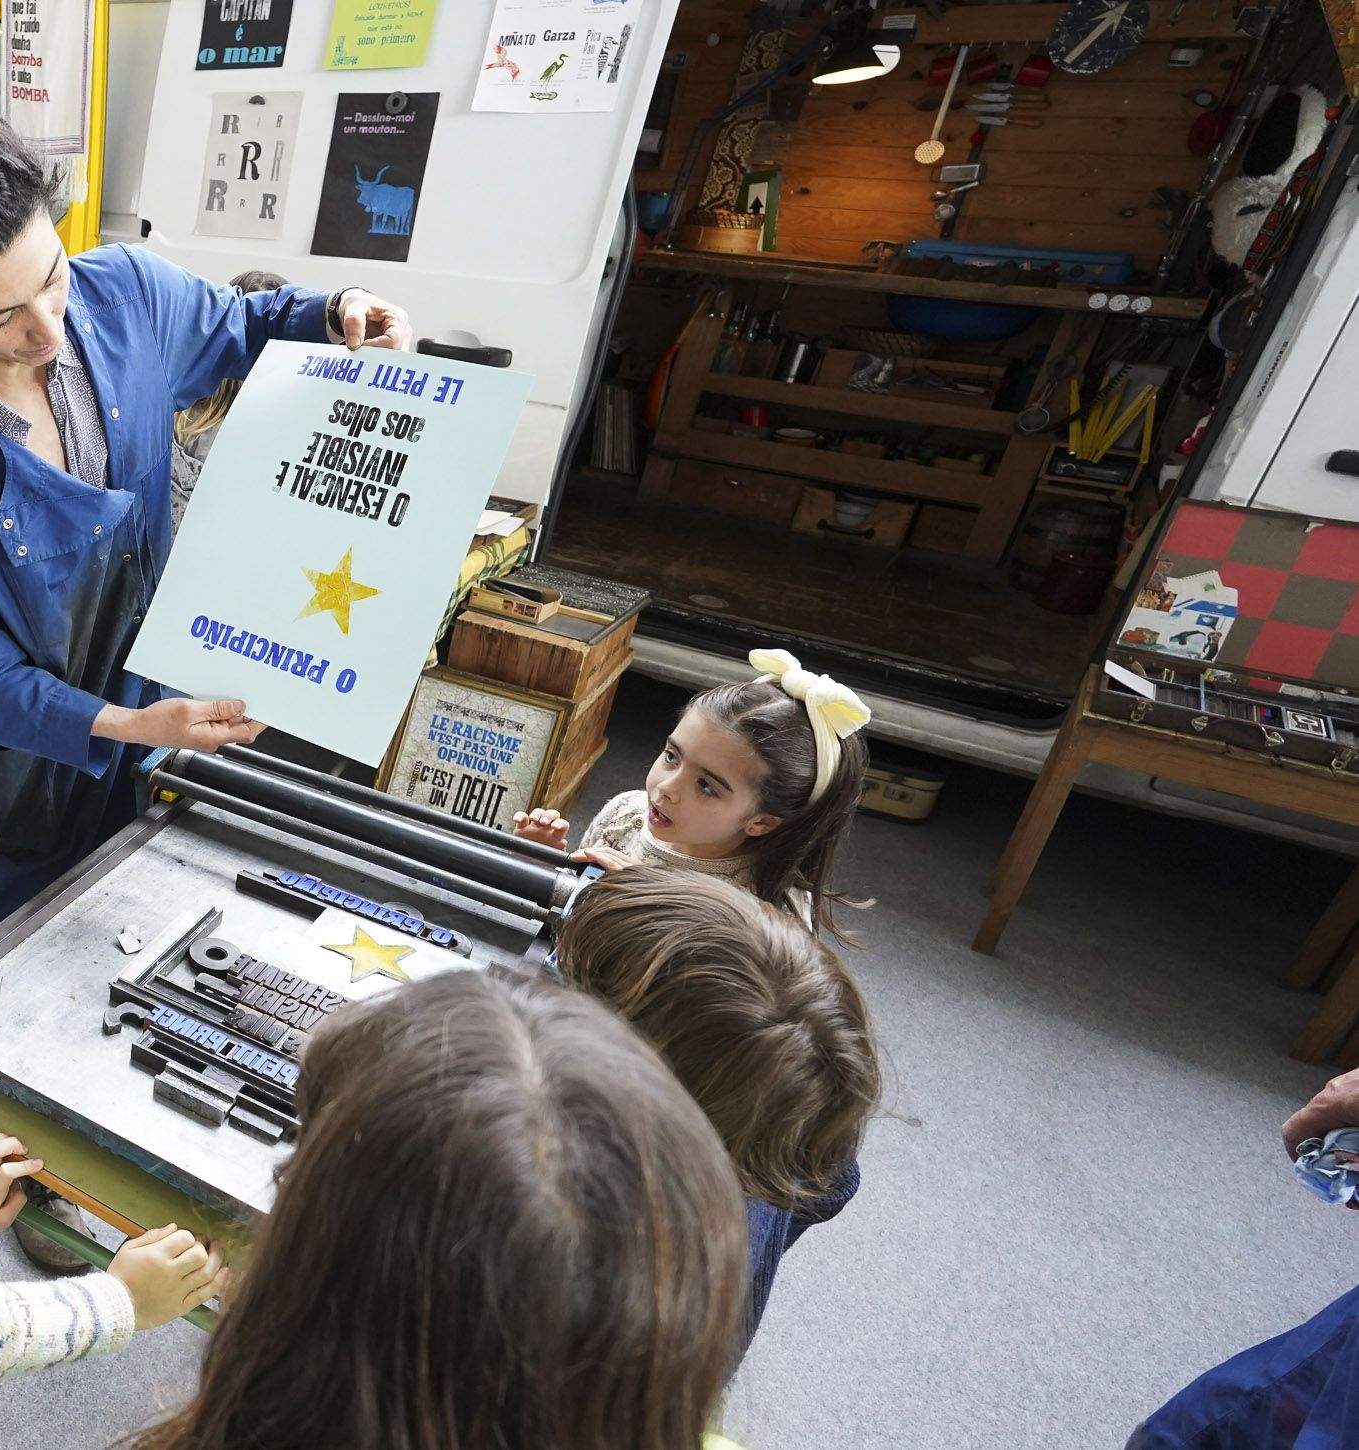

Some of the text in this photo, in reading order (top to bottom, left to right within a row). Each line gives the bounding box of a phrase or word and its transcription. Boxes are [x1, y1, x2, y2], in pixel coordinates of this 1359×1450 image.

[235, 24, 243, 42] é
[499, 32, 536, 47] MIÑATO
[543, 29, 576, 42] Garza
[11, 51, 42, 67] bomba
[198, 45, 283, 64] o mar
[12, 86, 50, 102] BOMBA
[220, 114, 240, 134] R
[344, 126, 356, 134] un
[354, 112, 415, 123] Dessine-moi
[217, 153, 227, 166] R
[237, 141, 262, 181] R
[271, 140, 284, 182] R
[205, 179, 228, 212] R
[258, 193, 277, 220] R
[297, 355, 464, 405] LE PETIT PRINCE
[328, 399, 426, 443] aos ollos
[302, 431, 408, 488] INVISIBLE
[289, 464, 389, 521] ESENCIAL
[387, 492, 411, 527] O
[190, 615, 357, 693] O PRINCIPIÑO
[427, 730, 515, 764] N'EST PAS UNE
[429, 714, 522, 754] LE RACISME
[419, 765, 455, 791] C'EST
[429, 787, 449, 808] UN
